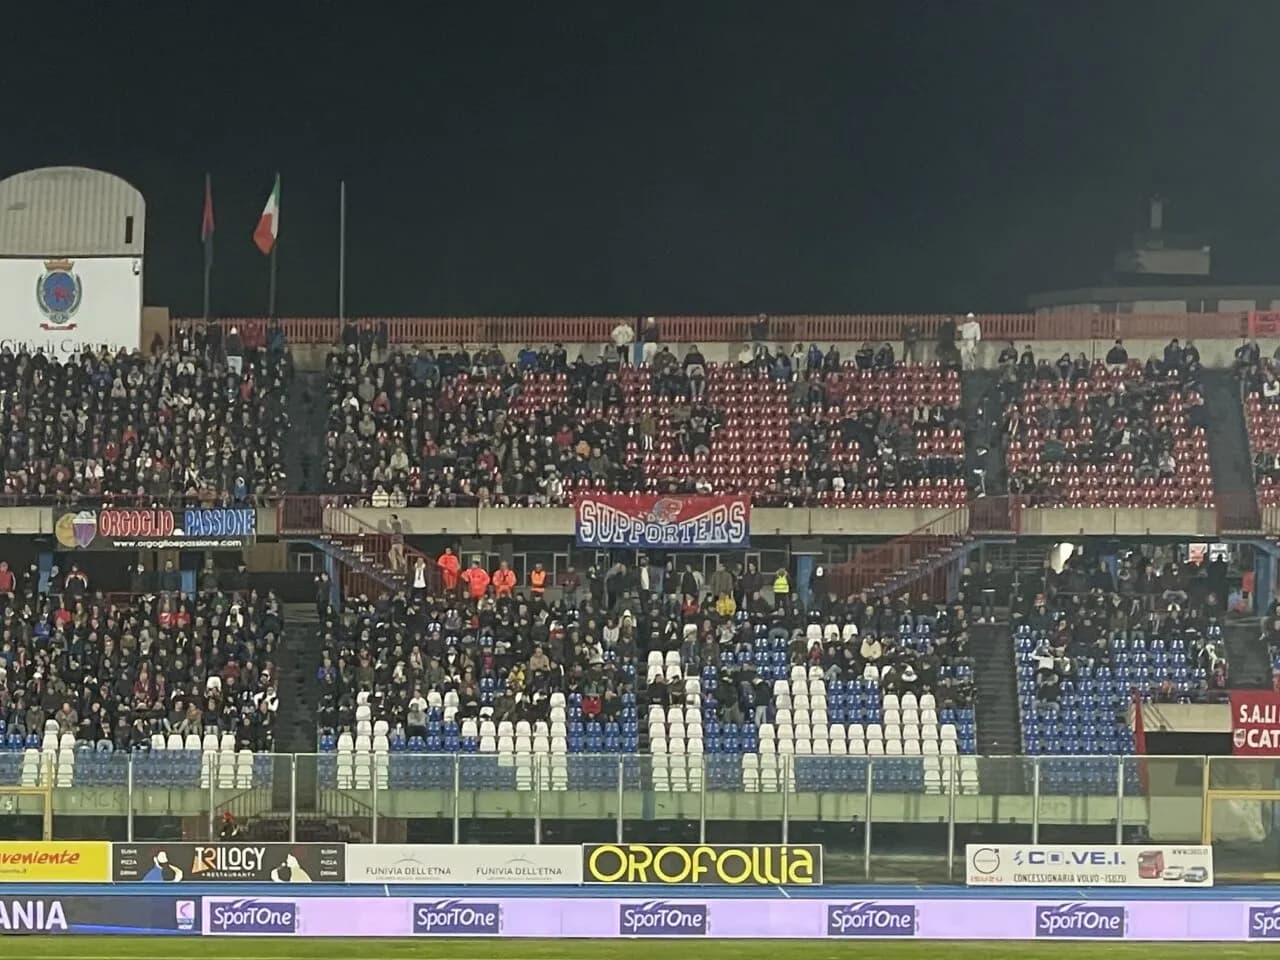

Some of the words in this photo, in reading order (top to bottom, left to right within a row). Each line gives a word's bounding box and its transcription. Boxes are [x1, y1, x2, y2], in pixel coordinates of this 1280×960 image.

[99, 509, 175, 537] ORGOGLIO
[184, 508, 256, 537] PASSIONE
[579, 499, 746, 544] SUPPORTERS
[1247, 728, 1280, 748] CAT
[194, 847, 266, 871] TRILOGY
[366, 866, 403, 876] FUNIVIA
[476, 866, 513, 876] FUNIVIA
[1013, 873, 1075, 883] CONCESSIONARIA
